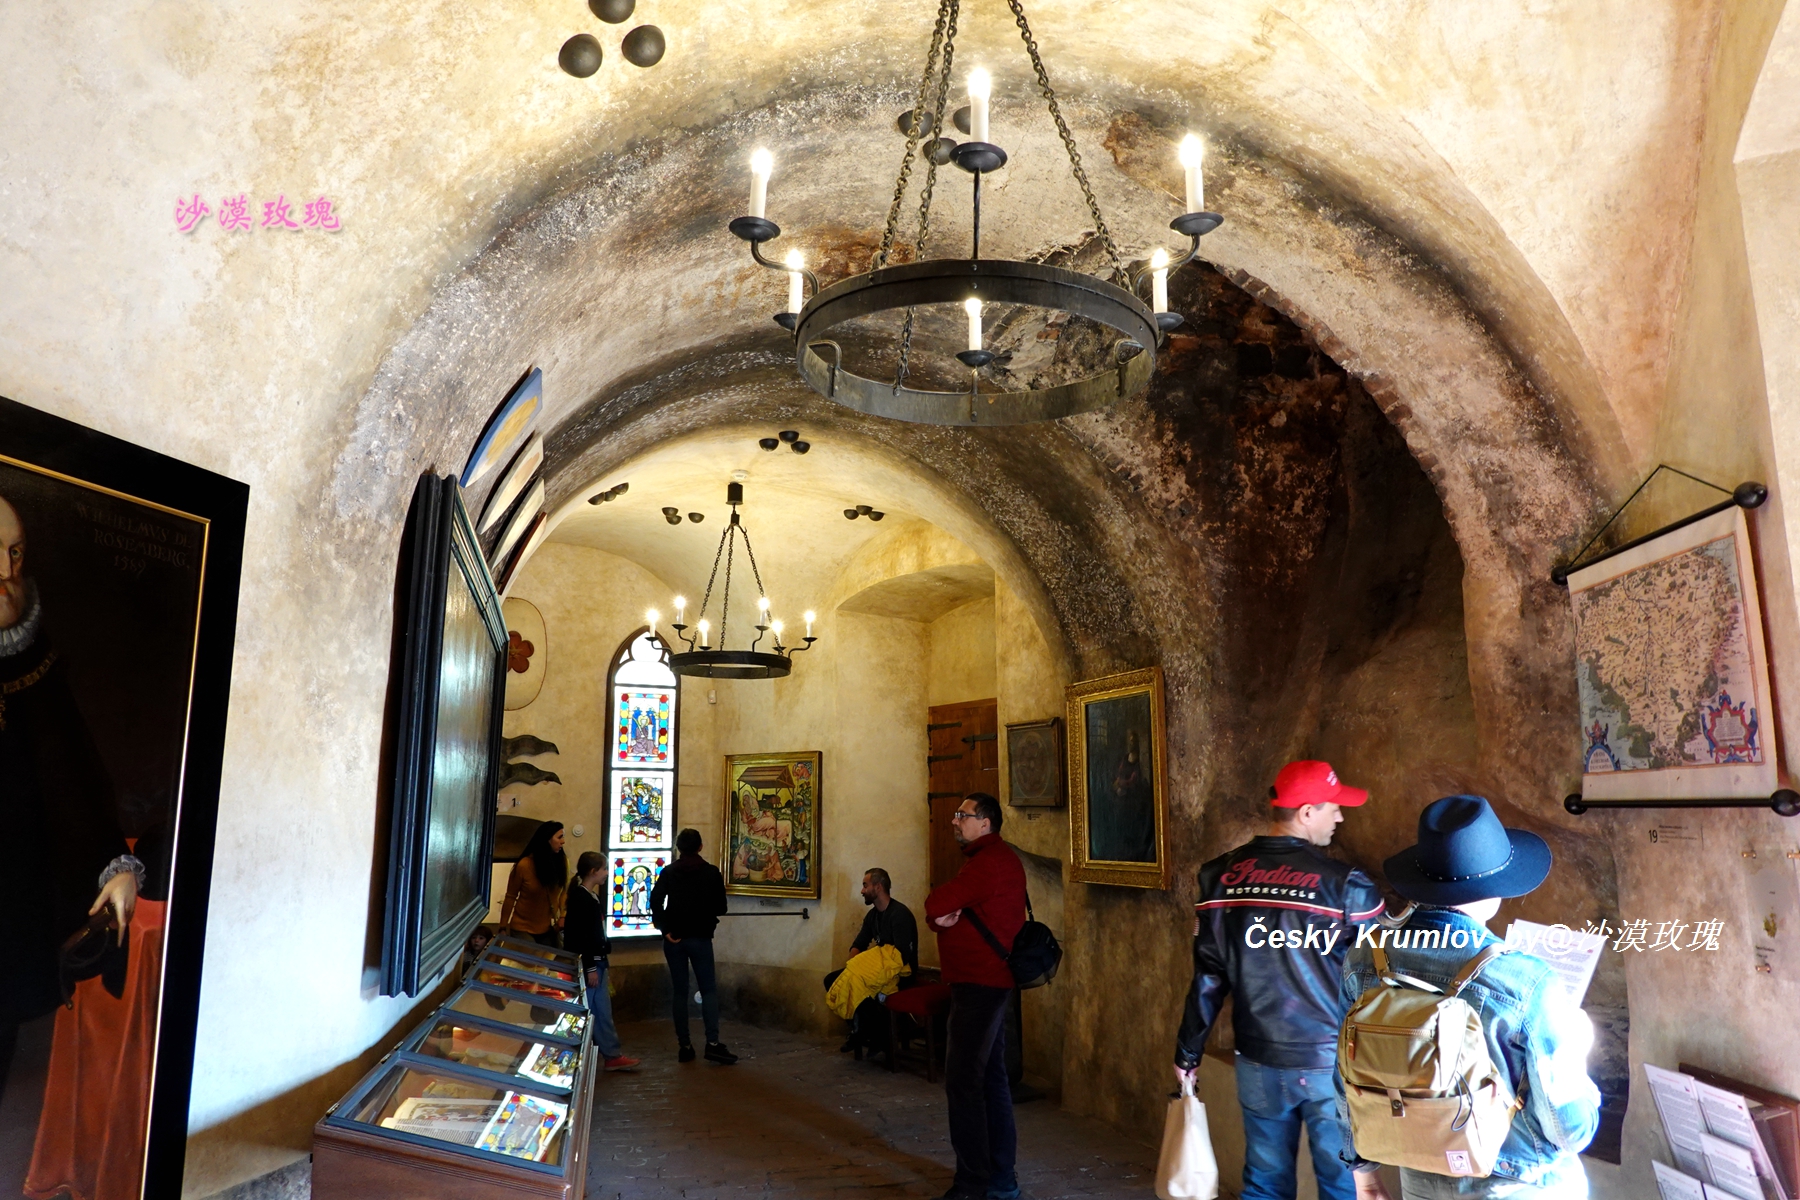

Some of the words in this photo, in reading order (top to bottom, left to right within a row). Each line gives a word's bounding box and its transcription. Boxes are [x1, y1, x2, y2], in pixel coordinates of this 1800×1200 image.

[113, 555, 147, 578] 1589
[1648, 829, 1658, 844] 19
[1220, 858, 1322, 889] Indian
[1226, 886, 1316, 899] MOTORCYCLE
